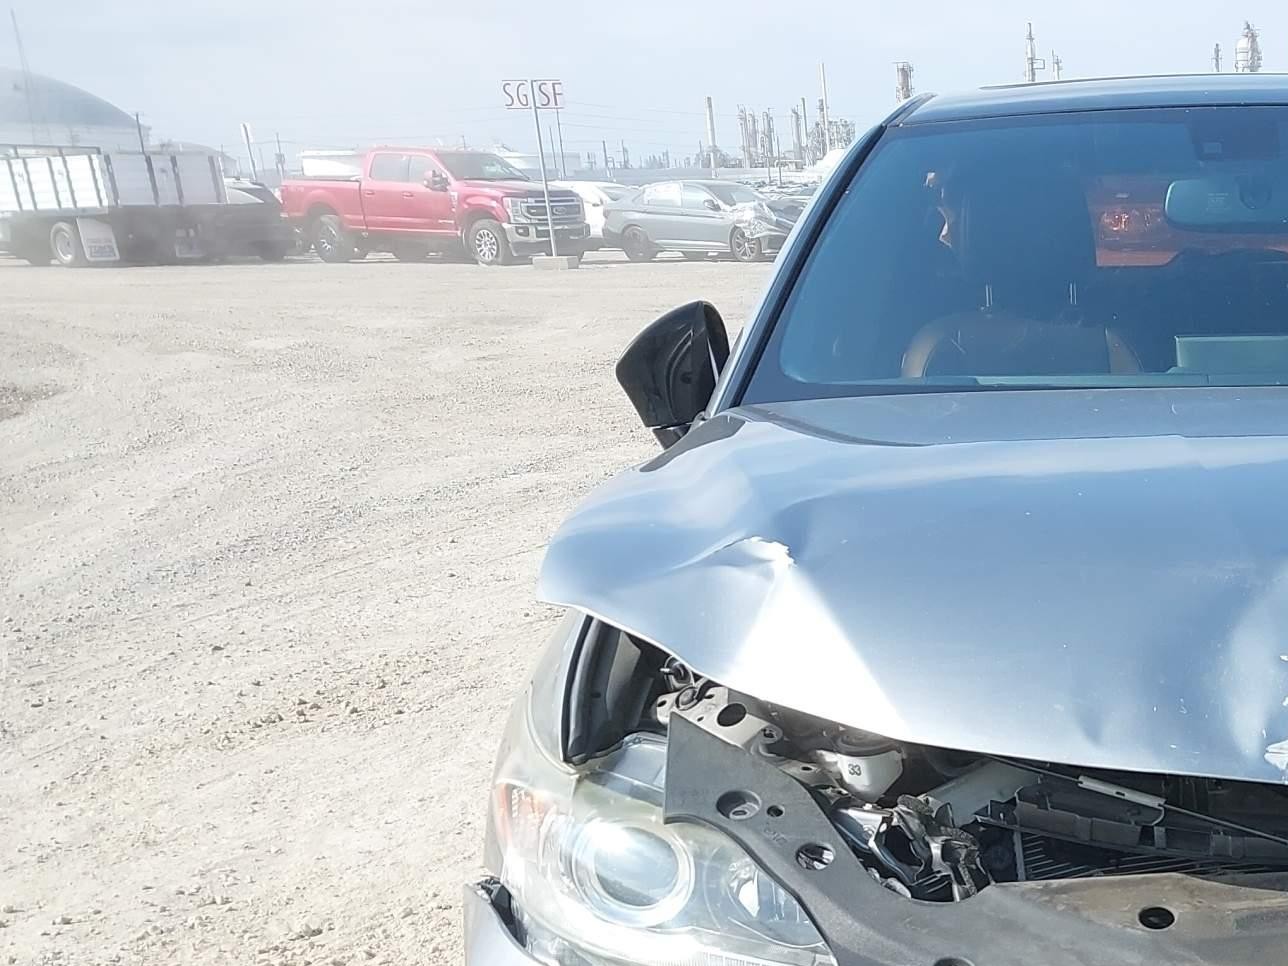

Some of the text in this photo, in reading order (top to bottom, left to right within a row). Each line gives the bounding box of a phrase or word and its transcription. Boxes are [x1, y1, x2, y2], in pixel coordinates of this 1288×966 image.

[503, 82, 563, 107] SG SF
[847, 763, 862, 776] 33
